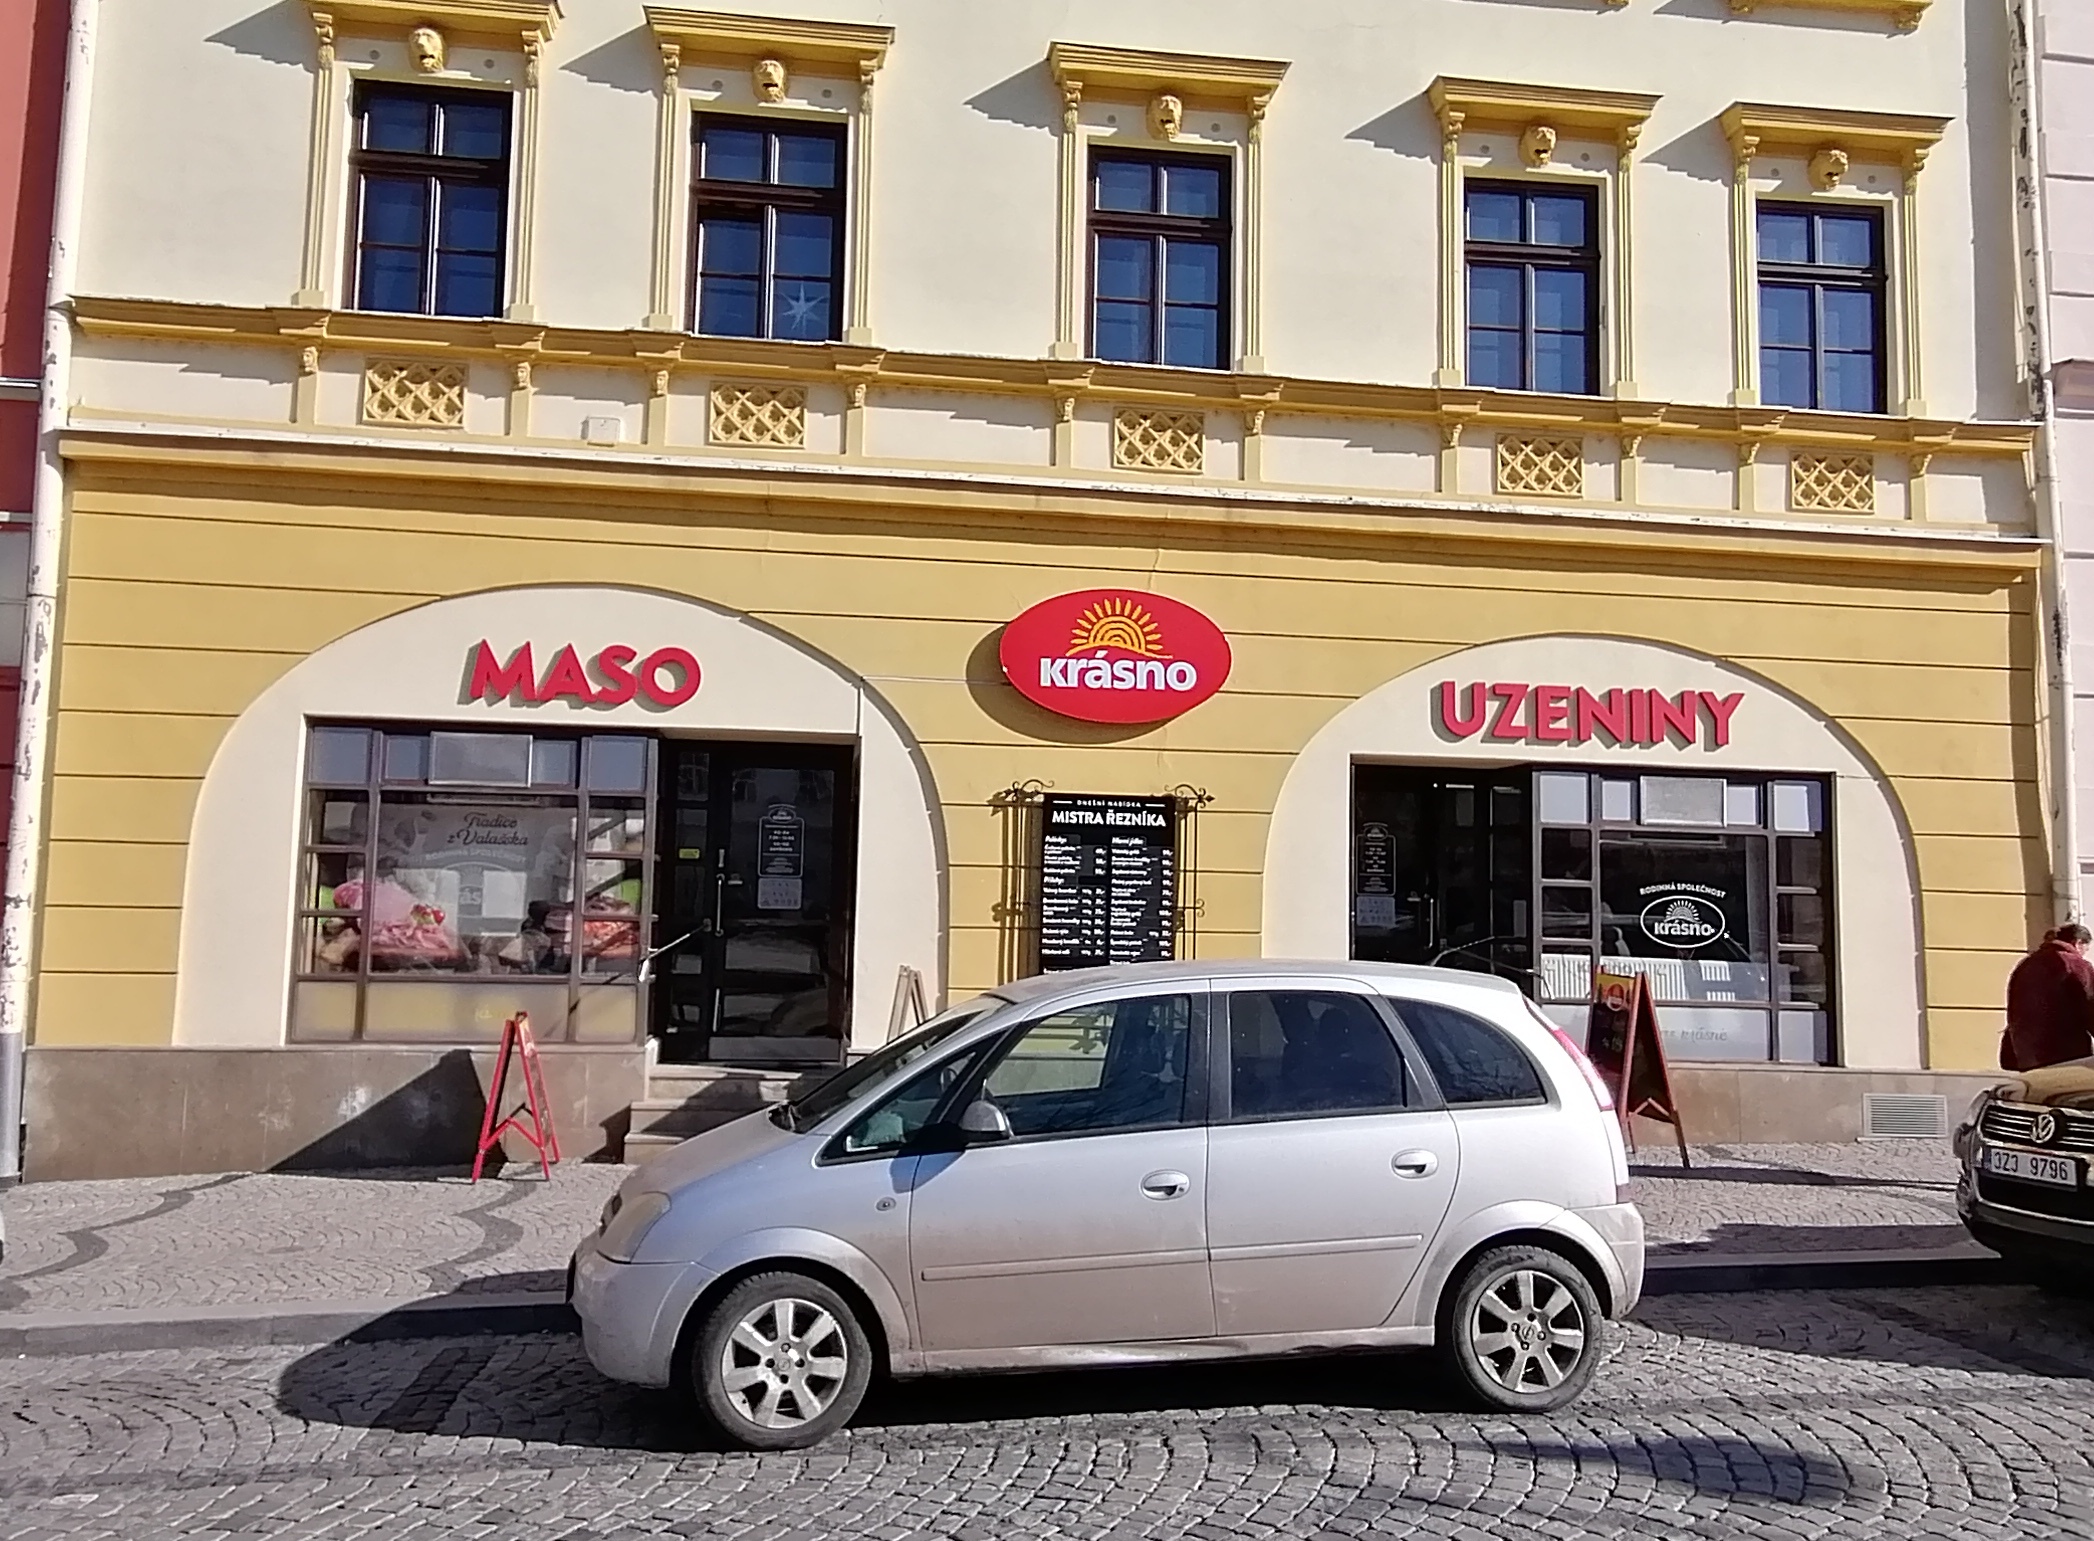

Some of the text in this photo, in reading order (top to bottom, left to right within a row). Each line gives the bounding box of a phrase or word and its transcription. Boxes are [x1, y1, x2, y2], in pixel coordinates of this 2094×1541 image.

[469, 639, 701, 707] MASO
[1039, 650, 1198, 692] krásno
[1441, 681, 1744, 746] UZENINY
[1051, 808, 1167, 827] MISTRA ŘEZNÍKA
[1639, 881, 1727, 899] RODINNÁ SPOLEČNOST
[1653, 920, 1713, 936] krásno
[2029, 1156, 2068, 1181] 9796
